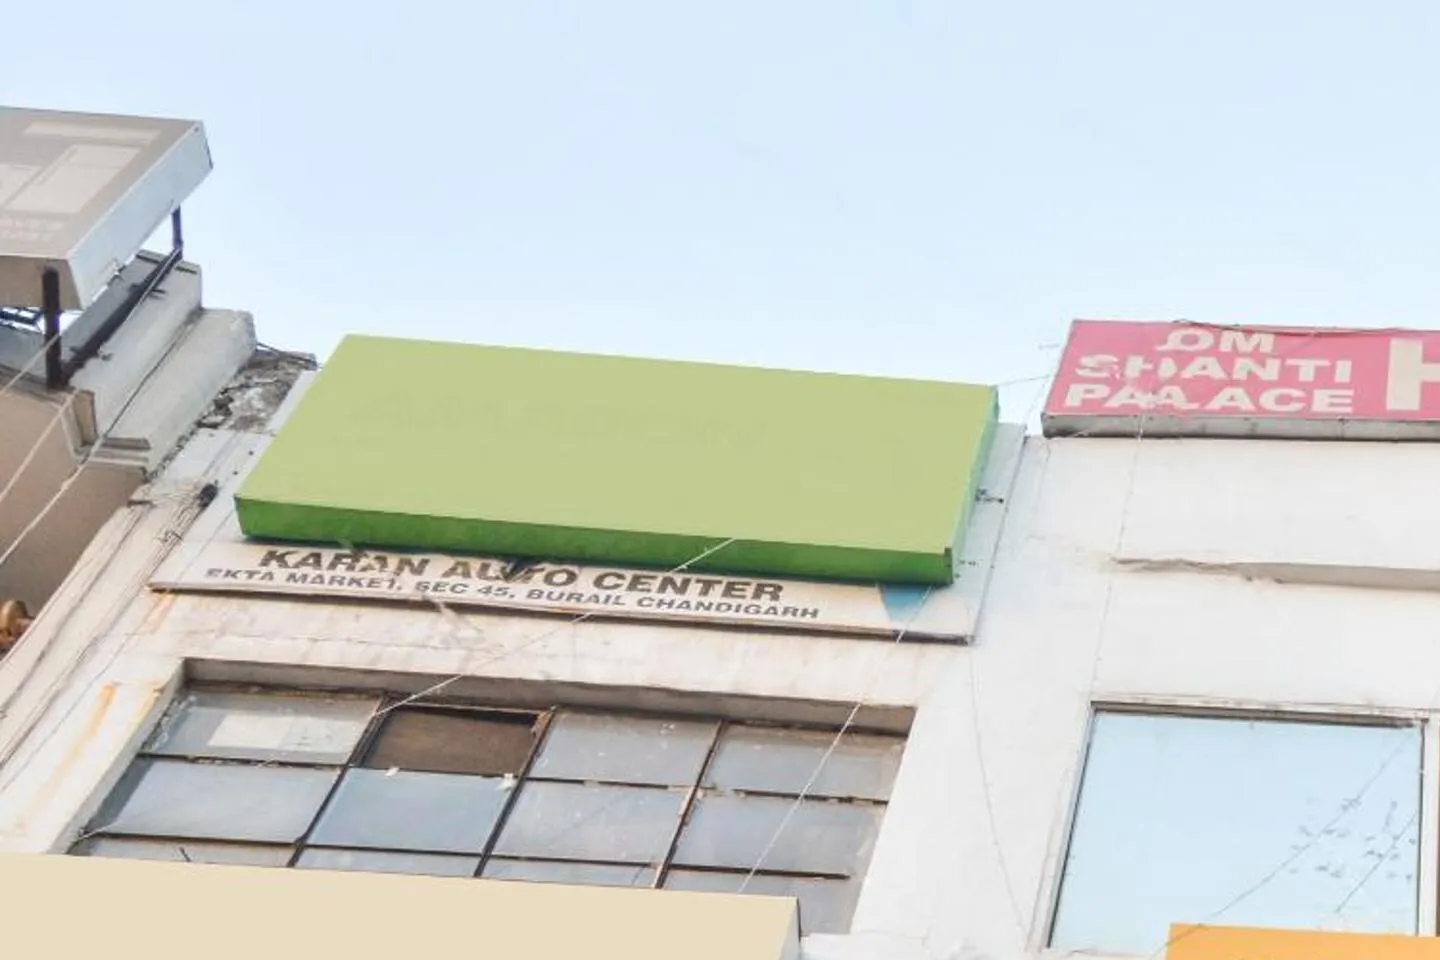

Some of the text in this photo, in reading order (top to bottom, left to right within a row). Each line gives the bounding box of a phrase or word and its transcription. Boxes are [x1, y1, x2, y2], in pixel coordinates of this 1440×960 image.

[1155, 328, 1276, 353] OM
[1074, 354, 1353, 383] SHANTI
[1064, 383, 1354, 414] PALACE
[258, 549, 430, 577] KARAN
[592, 571, 784, 601] CENTER
[415, 580, 470, 594] SEC
[527, 588, 626, 606] BURAIL
[636, 596, 820, 619] CHANDIGARH
